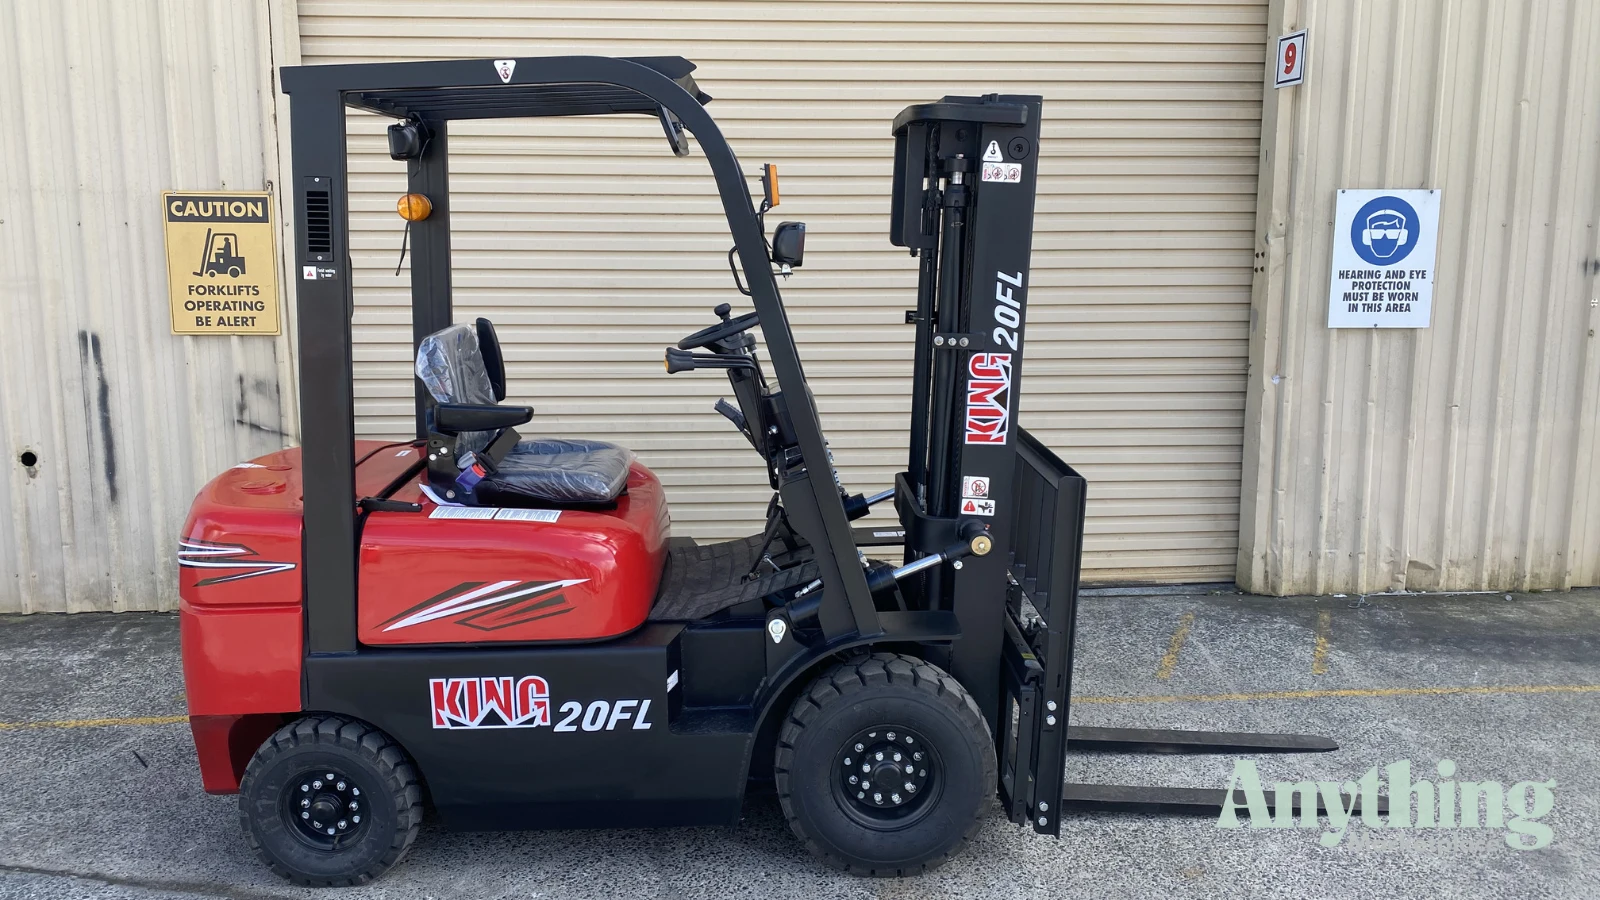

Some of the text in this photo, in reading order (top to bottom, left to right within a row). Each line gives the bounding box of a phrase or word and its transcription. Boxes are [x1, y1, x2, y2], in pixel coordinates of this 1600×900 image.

[1284, 42, 1297, 75] 9
[170, 200, 263, 218] CAUTION
[1338, 269, 1427, 280] HEARING AND EYE
[188, 284, 260, 296] FORKLIFTS
[1351, 281, 1411, 291] PROTECTION
[1342, 292, 1419, 302] MUST BE WORN
[184, 300, 265, 312] OPERATING
[1348, 303, 1411, 313] IN THIS AREA
[195, 316, 257, 327] BE ALERT
[964, 270, 1023, 445] KING 20FL
[428, 675, 652, 733] KING 20FL
